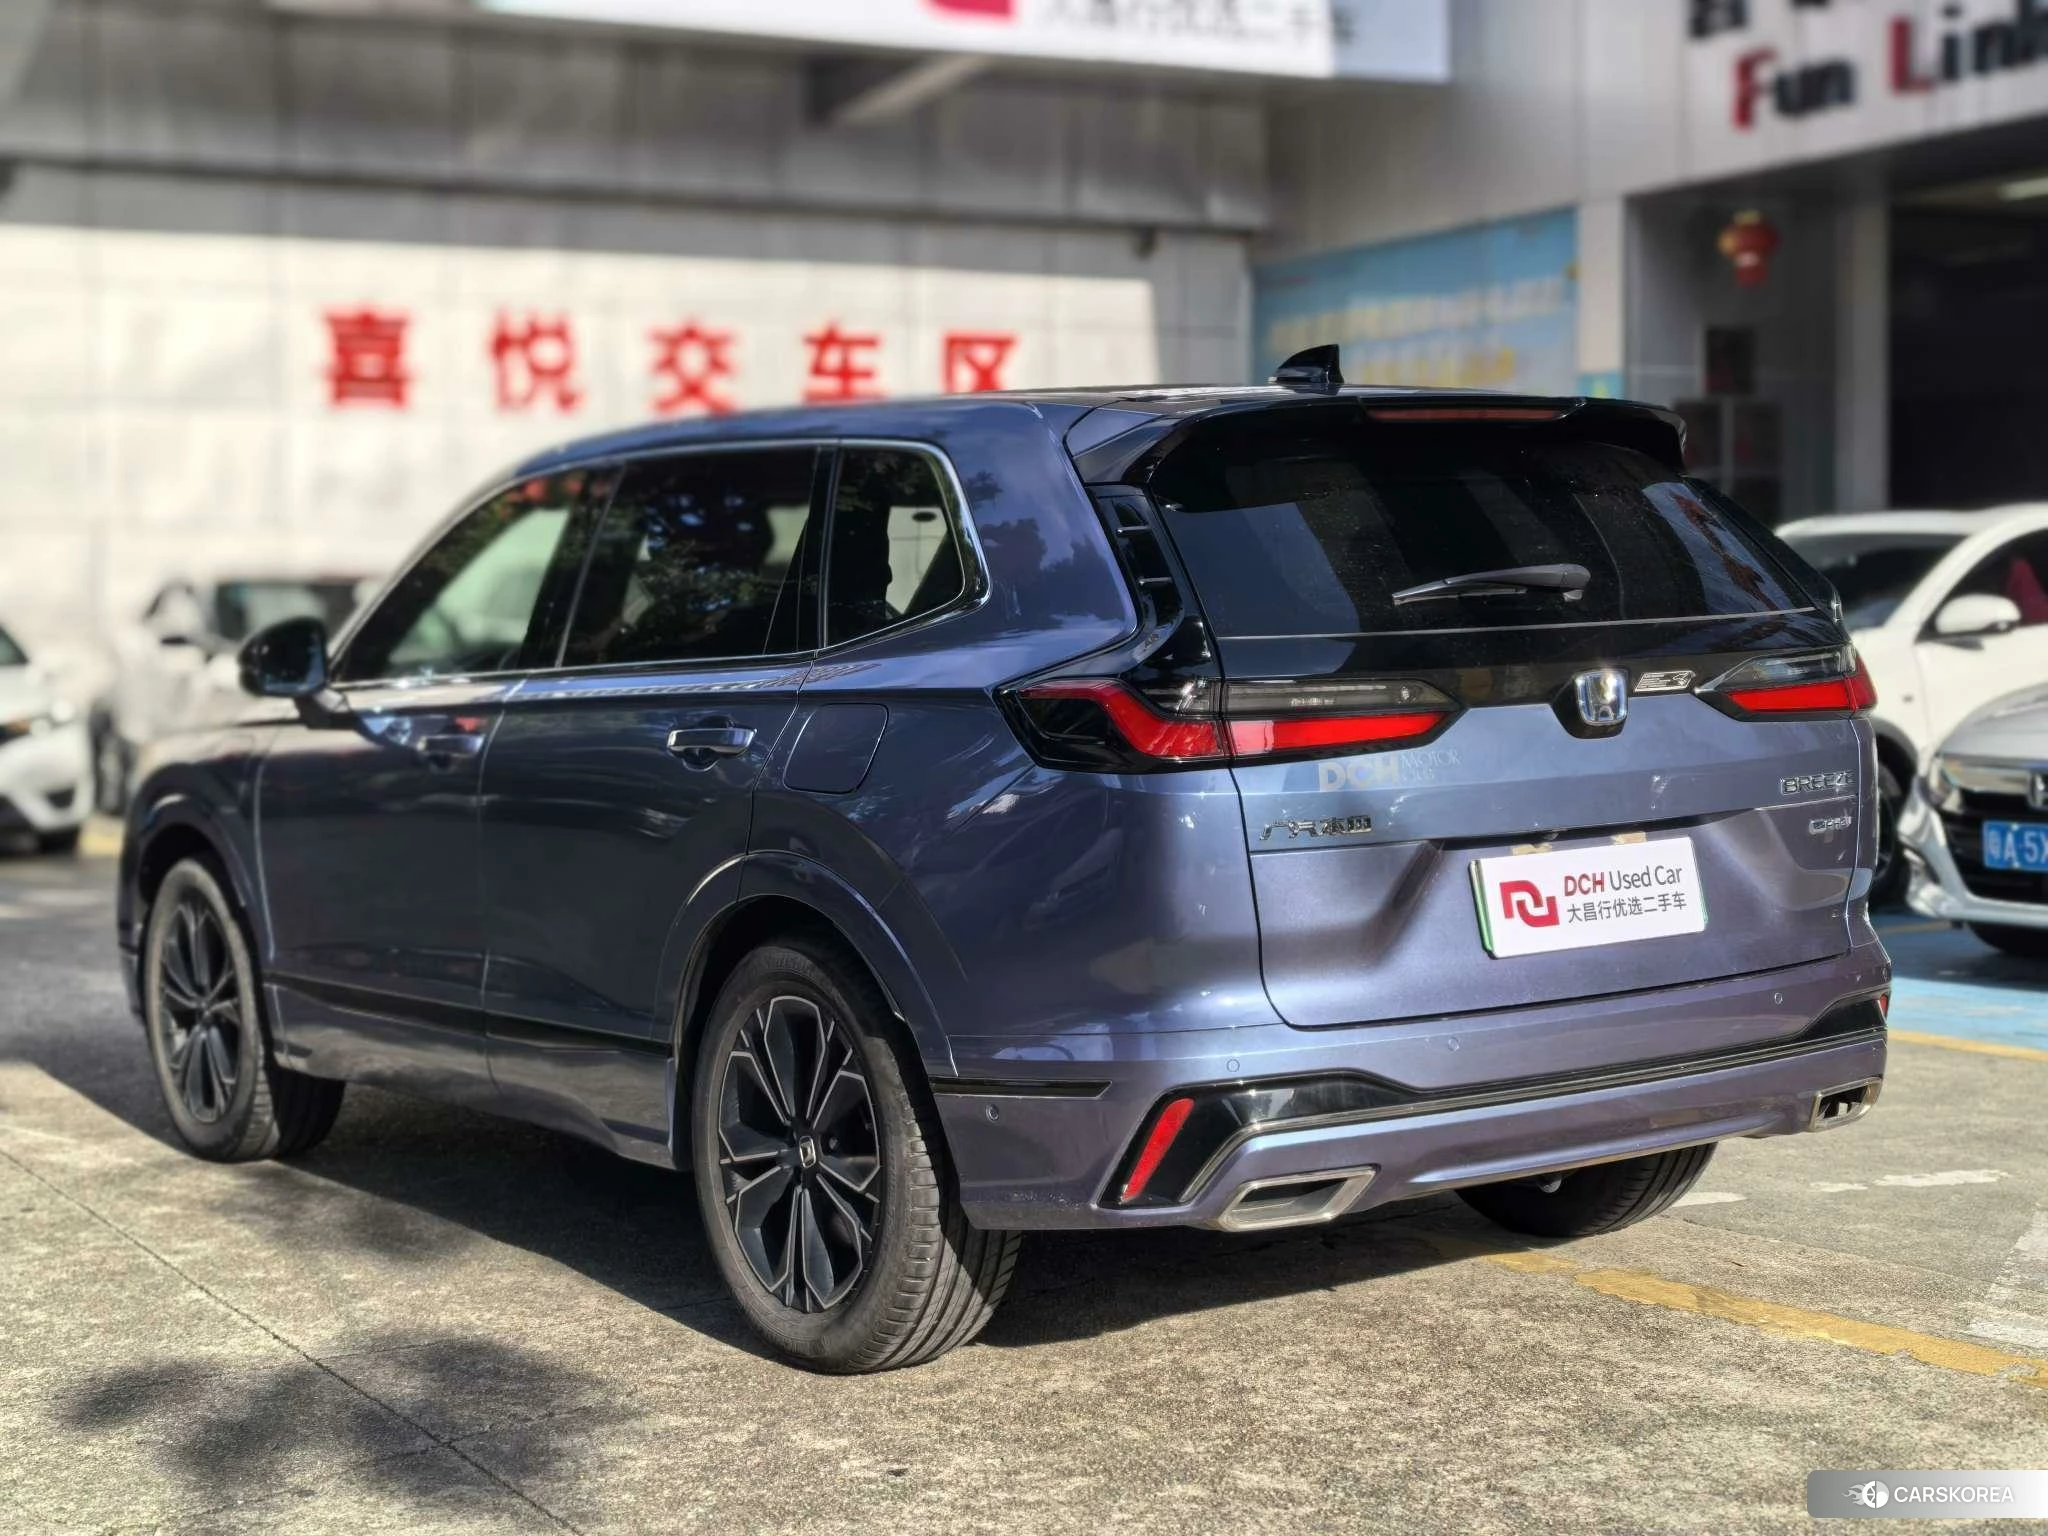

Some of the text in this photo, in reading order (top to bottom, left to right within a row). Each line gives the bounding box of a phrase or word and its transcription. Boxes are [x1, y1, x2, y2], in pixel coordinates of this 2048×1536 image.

[1732, 47, 1855, 131] Fun
[326, 308, 1017, 413] 喜悦交车区
[1319, 755, 1399, 791] DCH
[1564, 865, 1682, 896] DCH Used Car
[1567, 891, 1688, 924] 大昌行优选二手车
